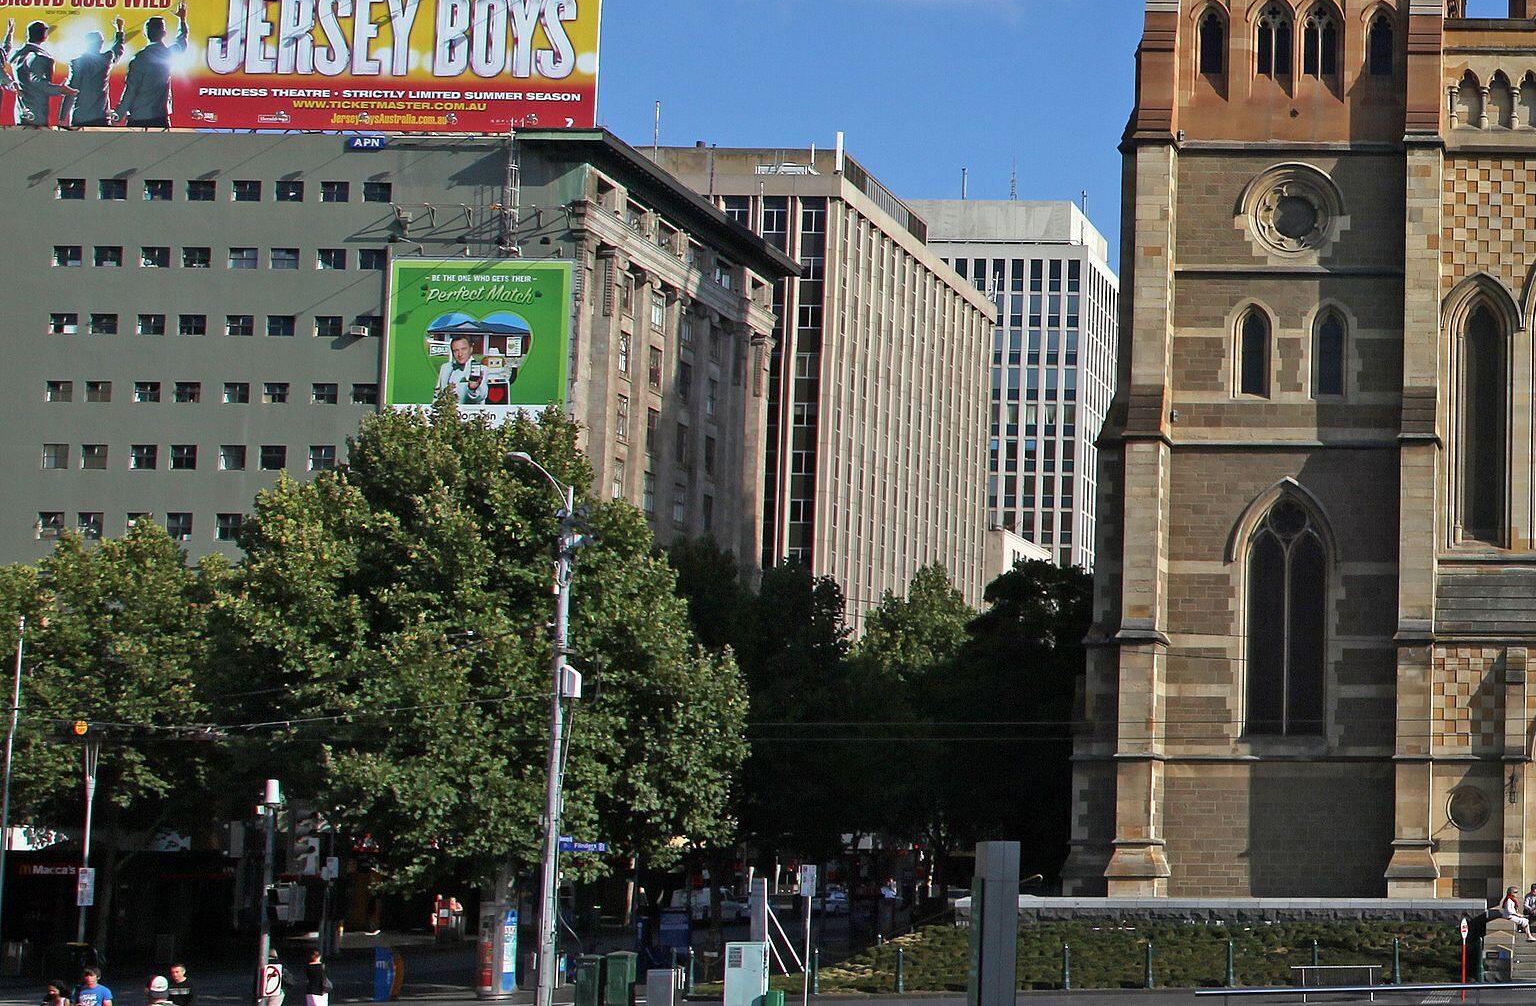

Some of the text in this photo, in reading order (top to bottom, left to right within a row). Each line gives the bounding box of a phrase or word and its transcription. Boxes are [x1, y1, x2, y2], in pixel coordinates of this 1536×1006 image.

[199, 87, 581, 102] PRINCESS THEATRE STRICTLY LIMITED SUMMER SEASON
[292, 100, 487, 111] WWW.TICKETMASTER.COM.AU
[330, 113, 448, 125] JerseyoysAustralia.com.au
[353, 138, 380, 147] APN
[431, 274, 441, 282] BE
[491, 275, 509, 283] GETS
[425, 284, 533, 305] Perfect Match
[32, 865, 76, 874] Macca's
